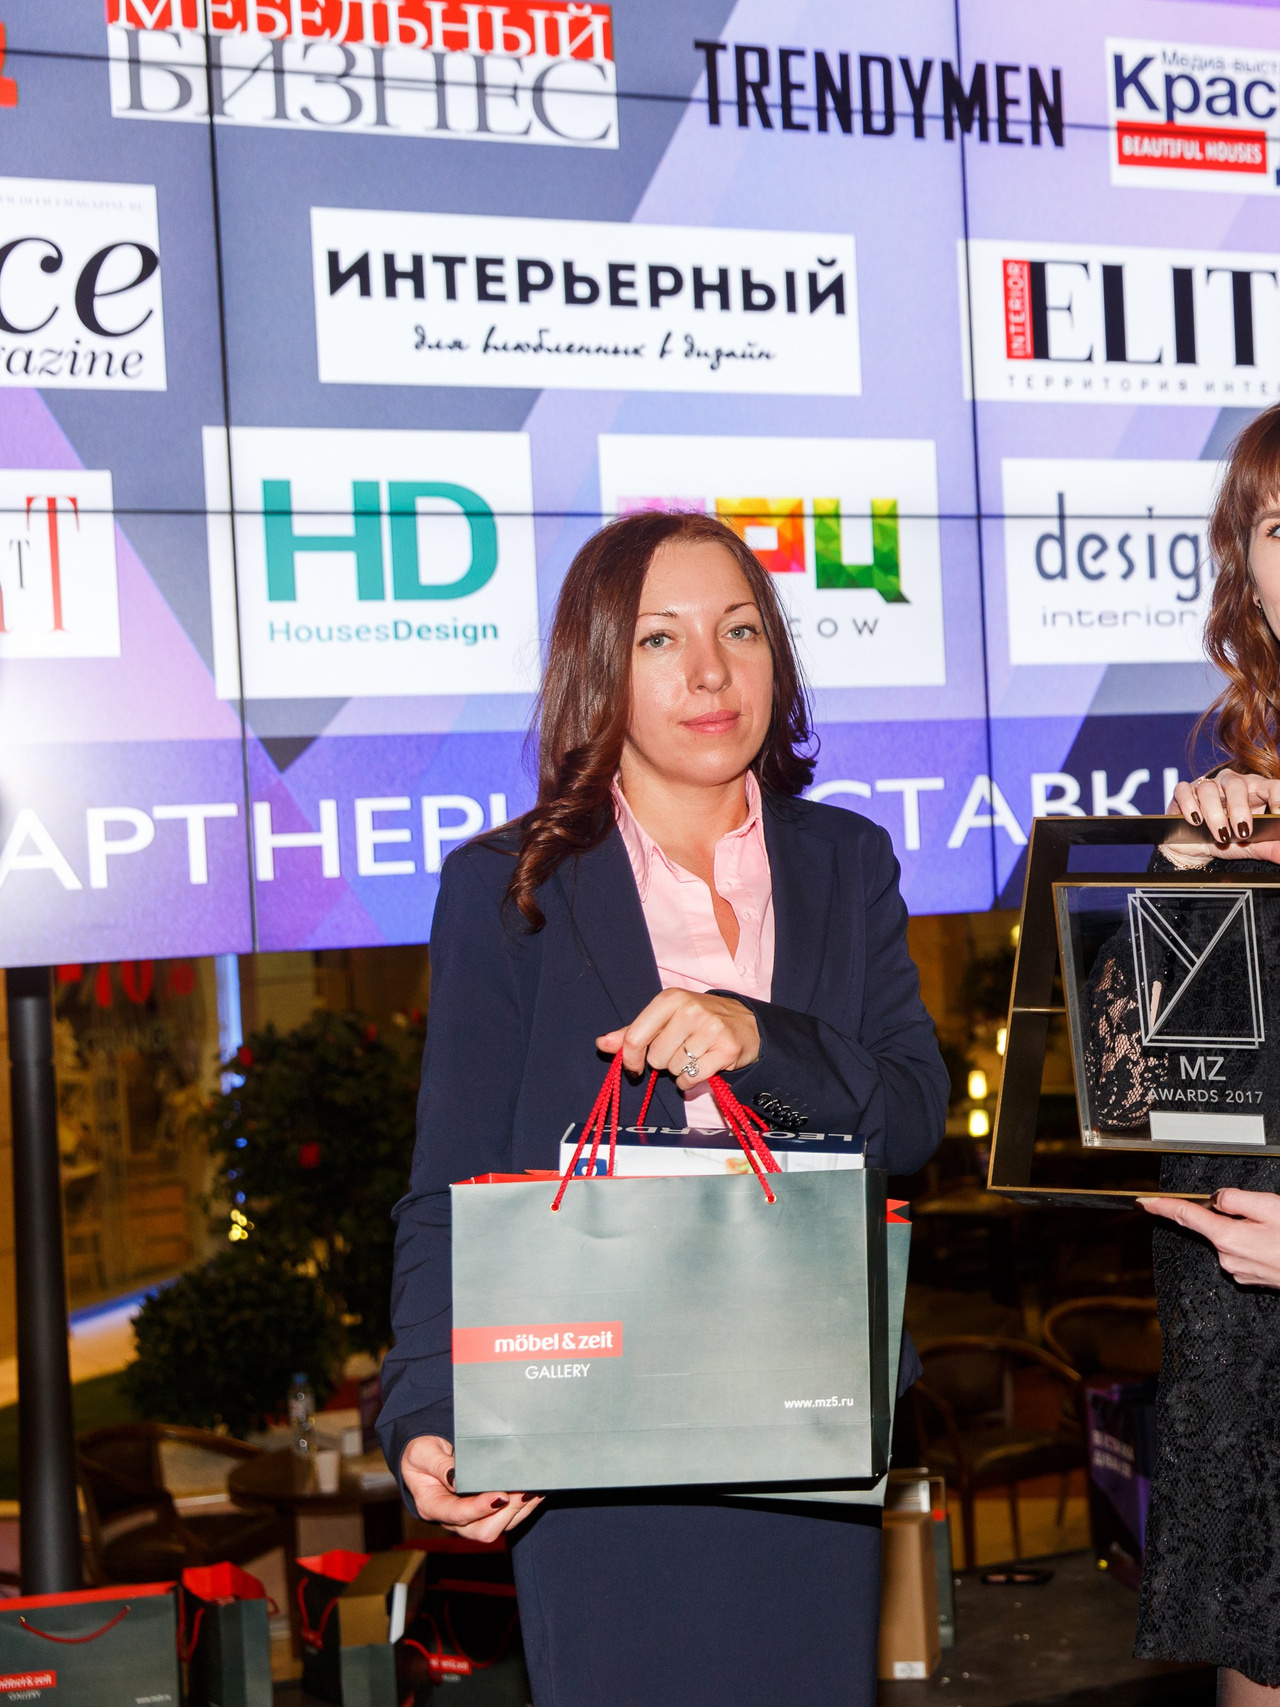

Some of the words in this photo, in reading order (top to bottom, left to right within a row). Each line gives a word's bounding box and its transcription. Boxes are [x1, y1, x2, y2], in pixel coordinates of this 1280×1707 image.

[116, 0, 610, 62] МЕБЕЛЬНЫЙ
[116, 28, 612, 142] БИЗНЕС
[694, 38, 1065, 148] TRENDYMEN
[1122, 134, 1203, 161] BEAUTIFUL
[1205, 141, 1263, 165] HOUSES
[327, 249, 846, 316] ИНТЕРЬЕРНЫЙ
[1008, 262, 1027, 358] INTERIOR
[0, 338, 144, 379] azine
[413, 324, 469, 351] для
[659, 330, 673, 359] в
[684, 332, 775, 371] дизайн
[1007, 375, 1188, 394] ТЕРРИТОРИЯ
[261, 479, 499, 602] HD
[1035, 491, 1215, 603] desig
[268, 616, 499, 647] HousesDesign
[0, 792, 510, 891] АРТНЕР
[1179, 1054, 1227, 1081] MZ
[1148, 1087, 1219, 1103] AWARDS
[1225, 1089, 1264, 1104] 2017
[524, 1362, 592, 1380] GALLERY
[783, 1395, 855, 1410] www.mz5.ru
